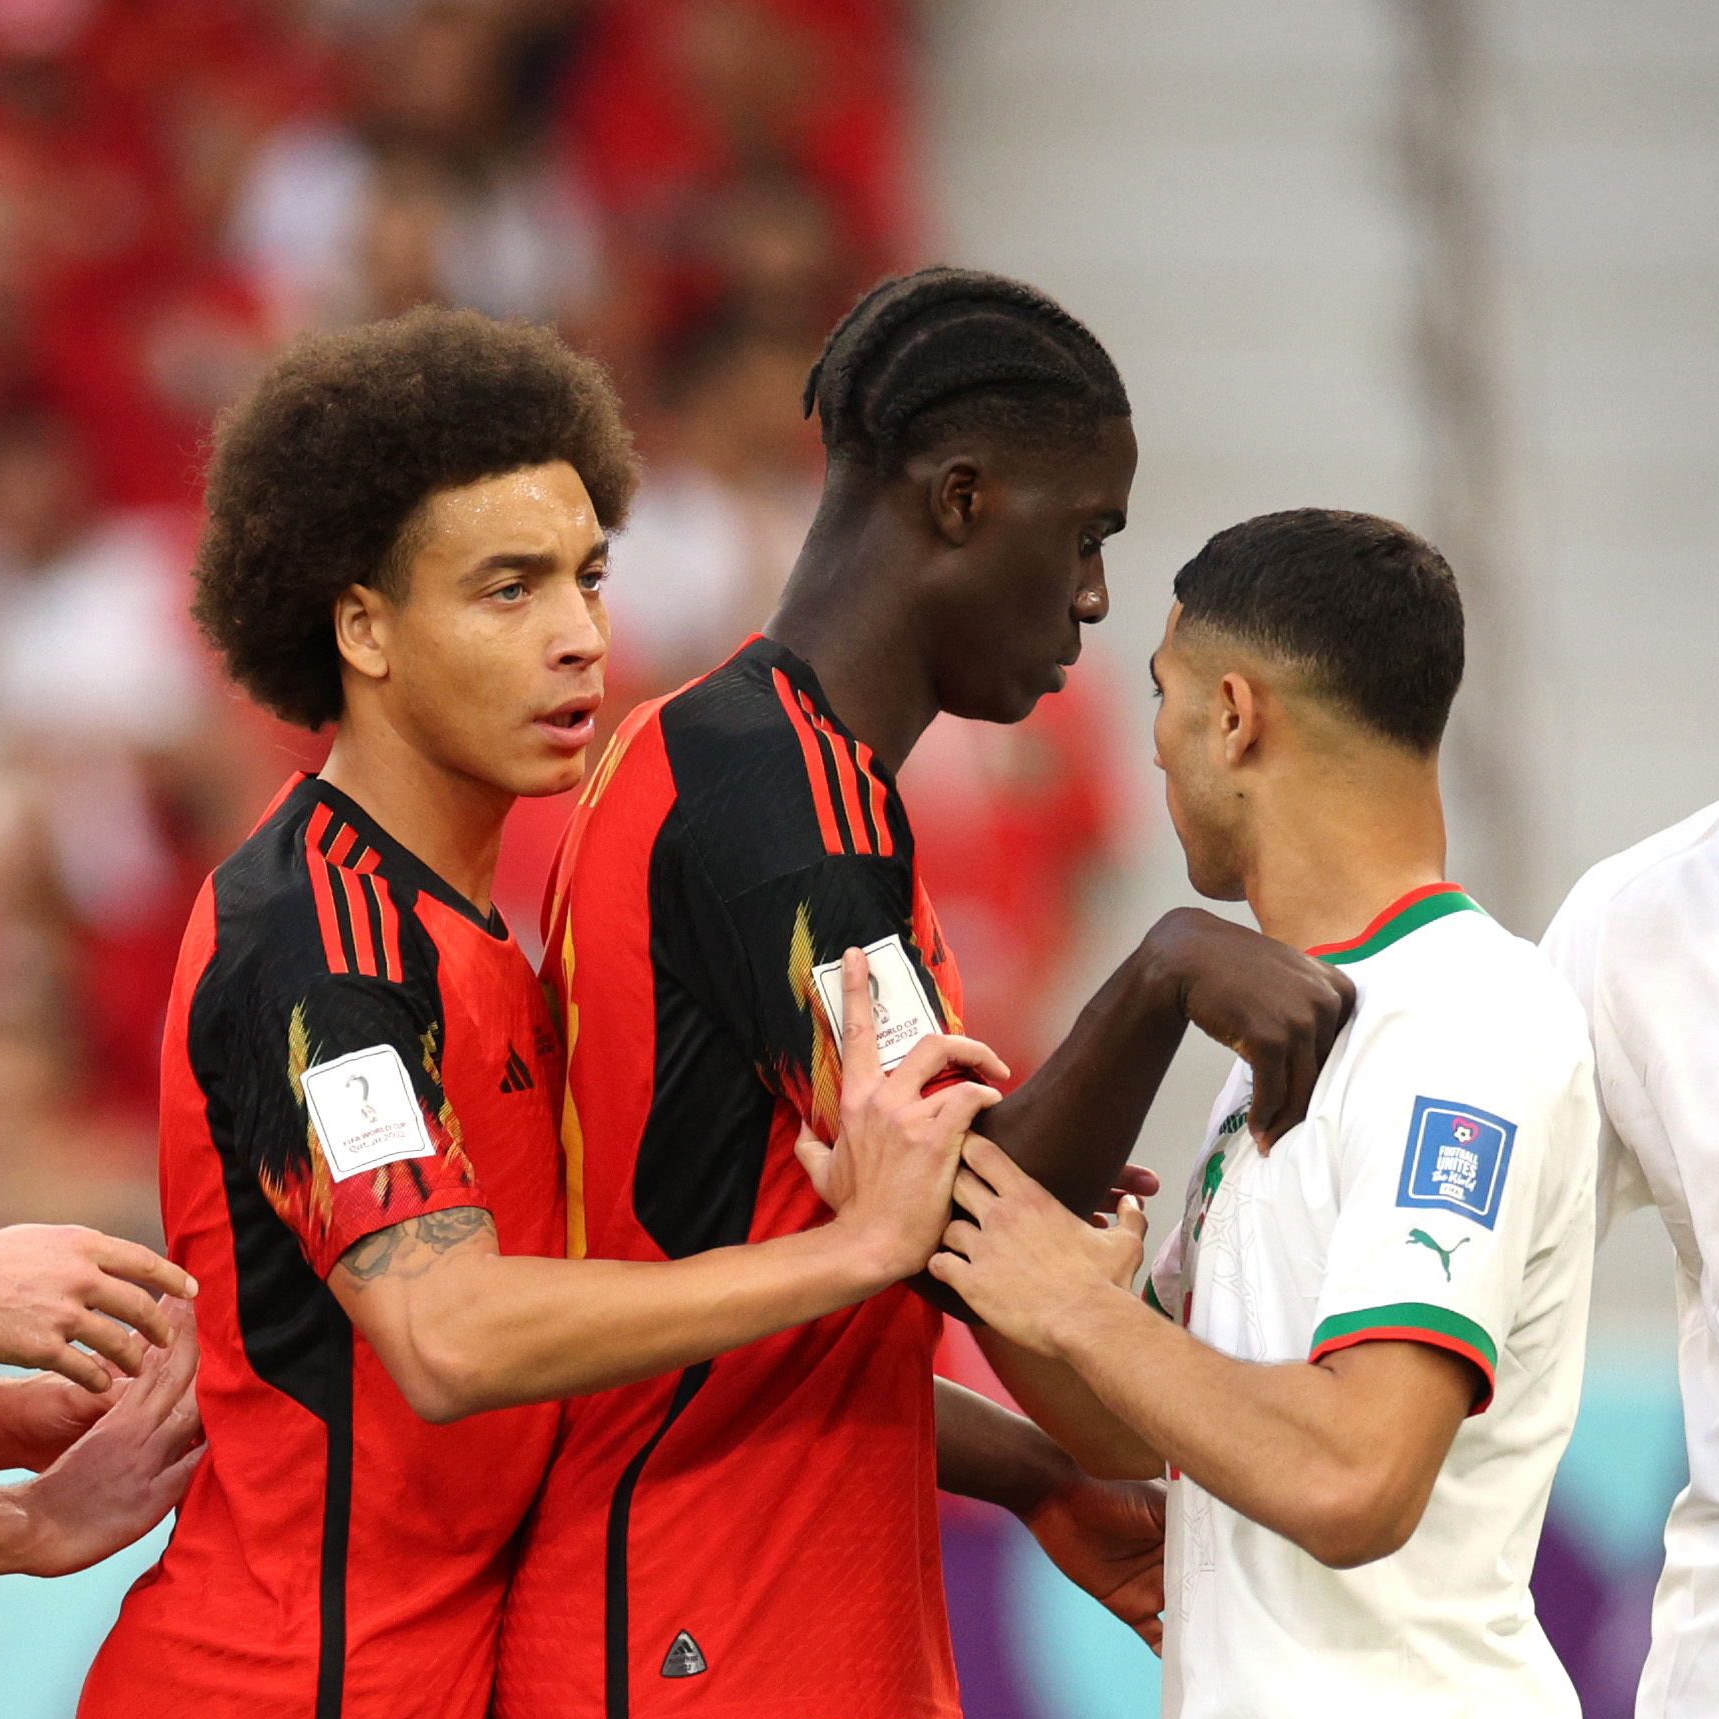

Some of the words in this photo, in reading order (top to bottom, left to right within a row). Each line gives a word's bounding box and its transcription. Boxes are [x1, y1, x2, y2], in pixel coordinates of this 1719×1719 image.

[904, 1017, 919, 1029] CUP
[342, 1136, 361, 1147] FIFA
[361, 1124, 392, 1139] WORLD
[1438, 1144, 1479, 1165] FOOTBALL
[1436, 1156, 1478, 1179] UNITES
